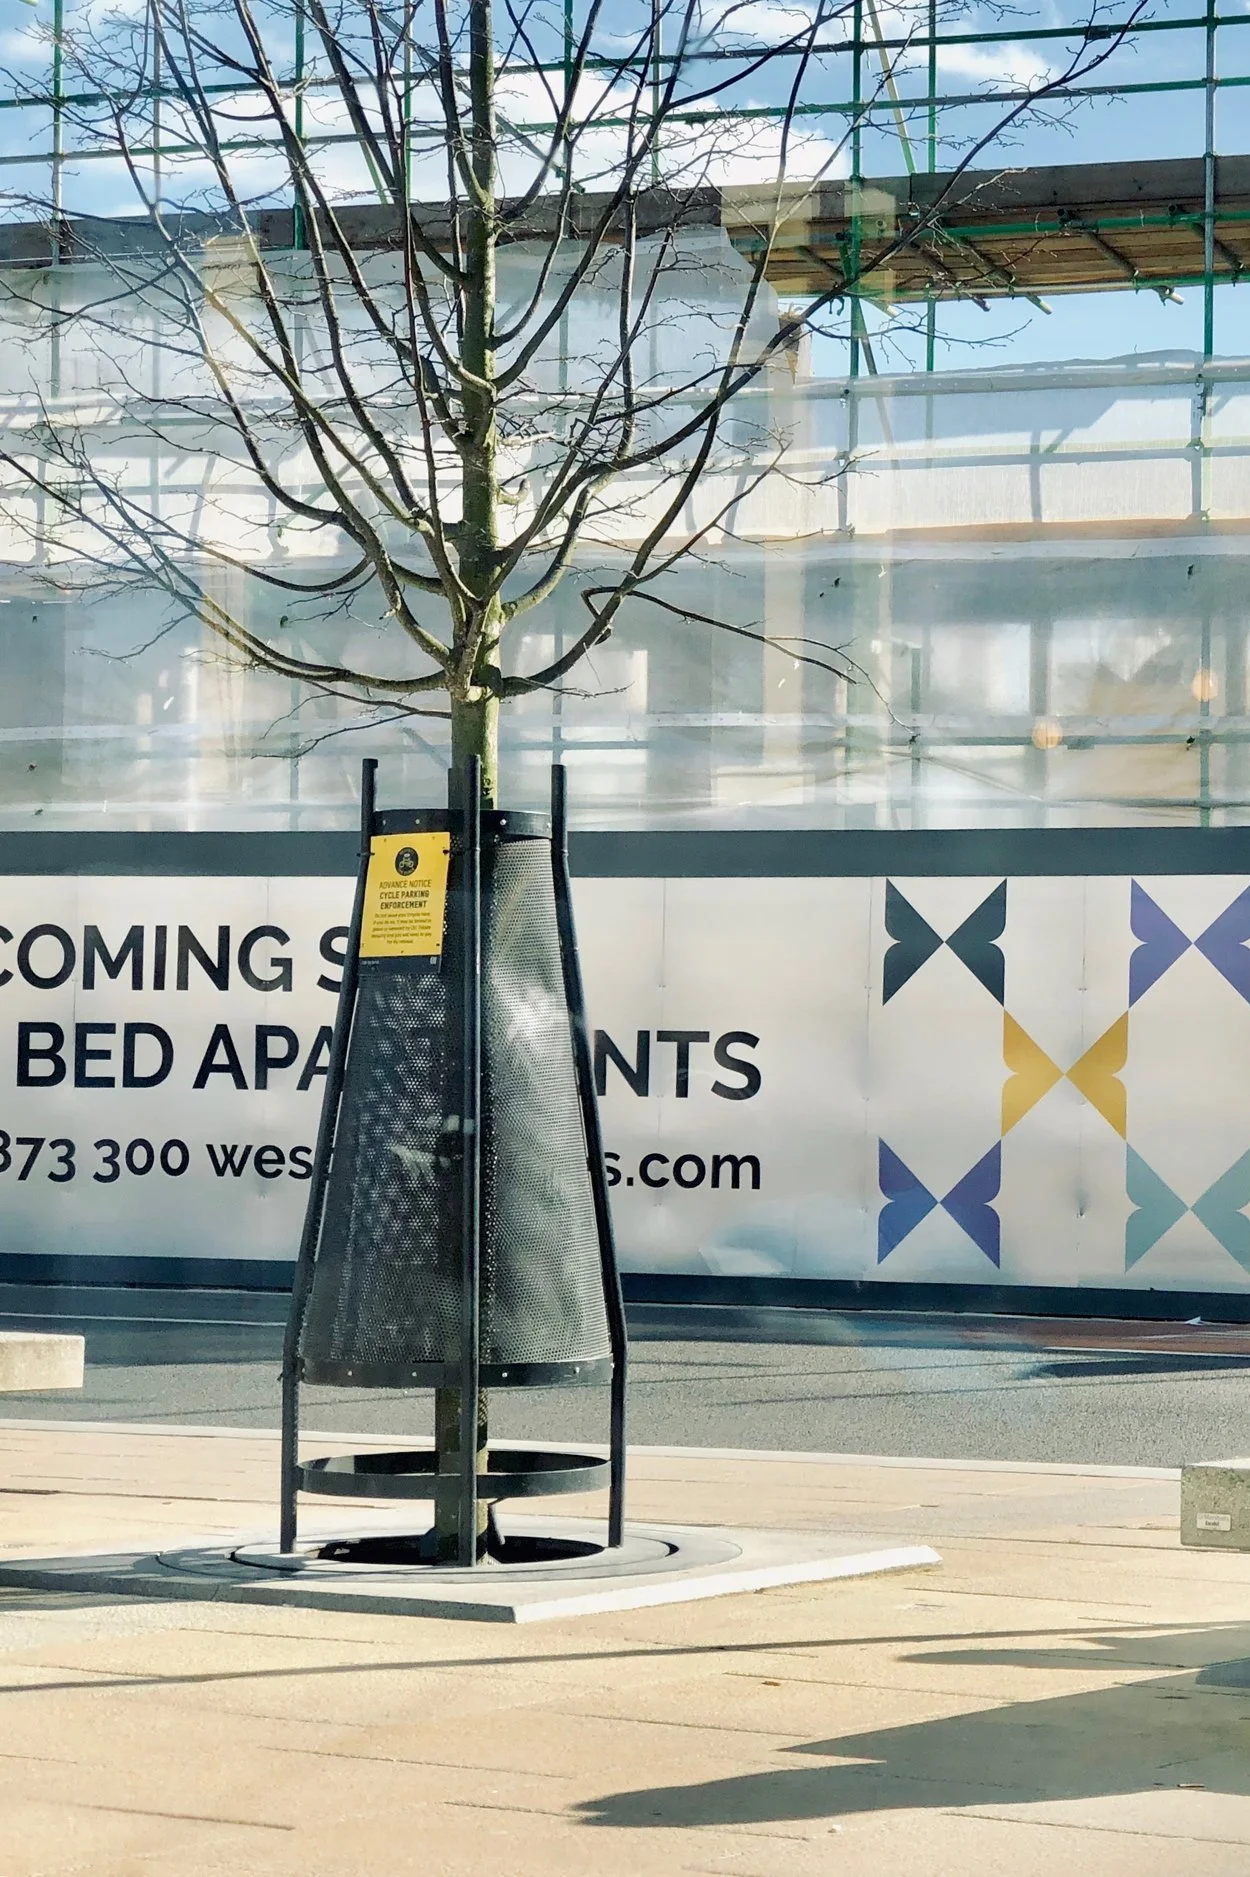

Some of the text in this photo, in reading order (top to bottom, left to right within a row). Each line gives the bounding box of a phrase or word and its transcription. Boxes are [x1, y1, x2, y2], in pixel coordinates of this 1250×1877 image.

[379, 880, 432, 889] ADVANCE NOTICE
[380, 890, 430, 899] CYCLE PARKING
[380, 900, 427, 910] ENFORCEMENT
[0, 923, 293, 992] OMING
[17, 1022, 174, 1088] BED
[93, 1138, 190, 1184] 300
